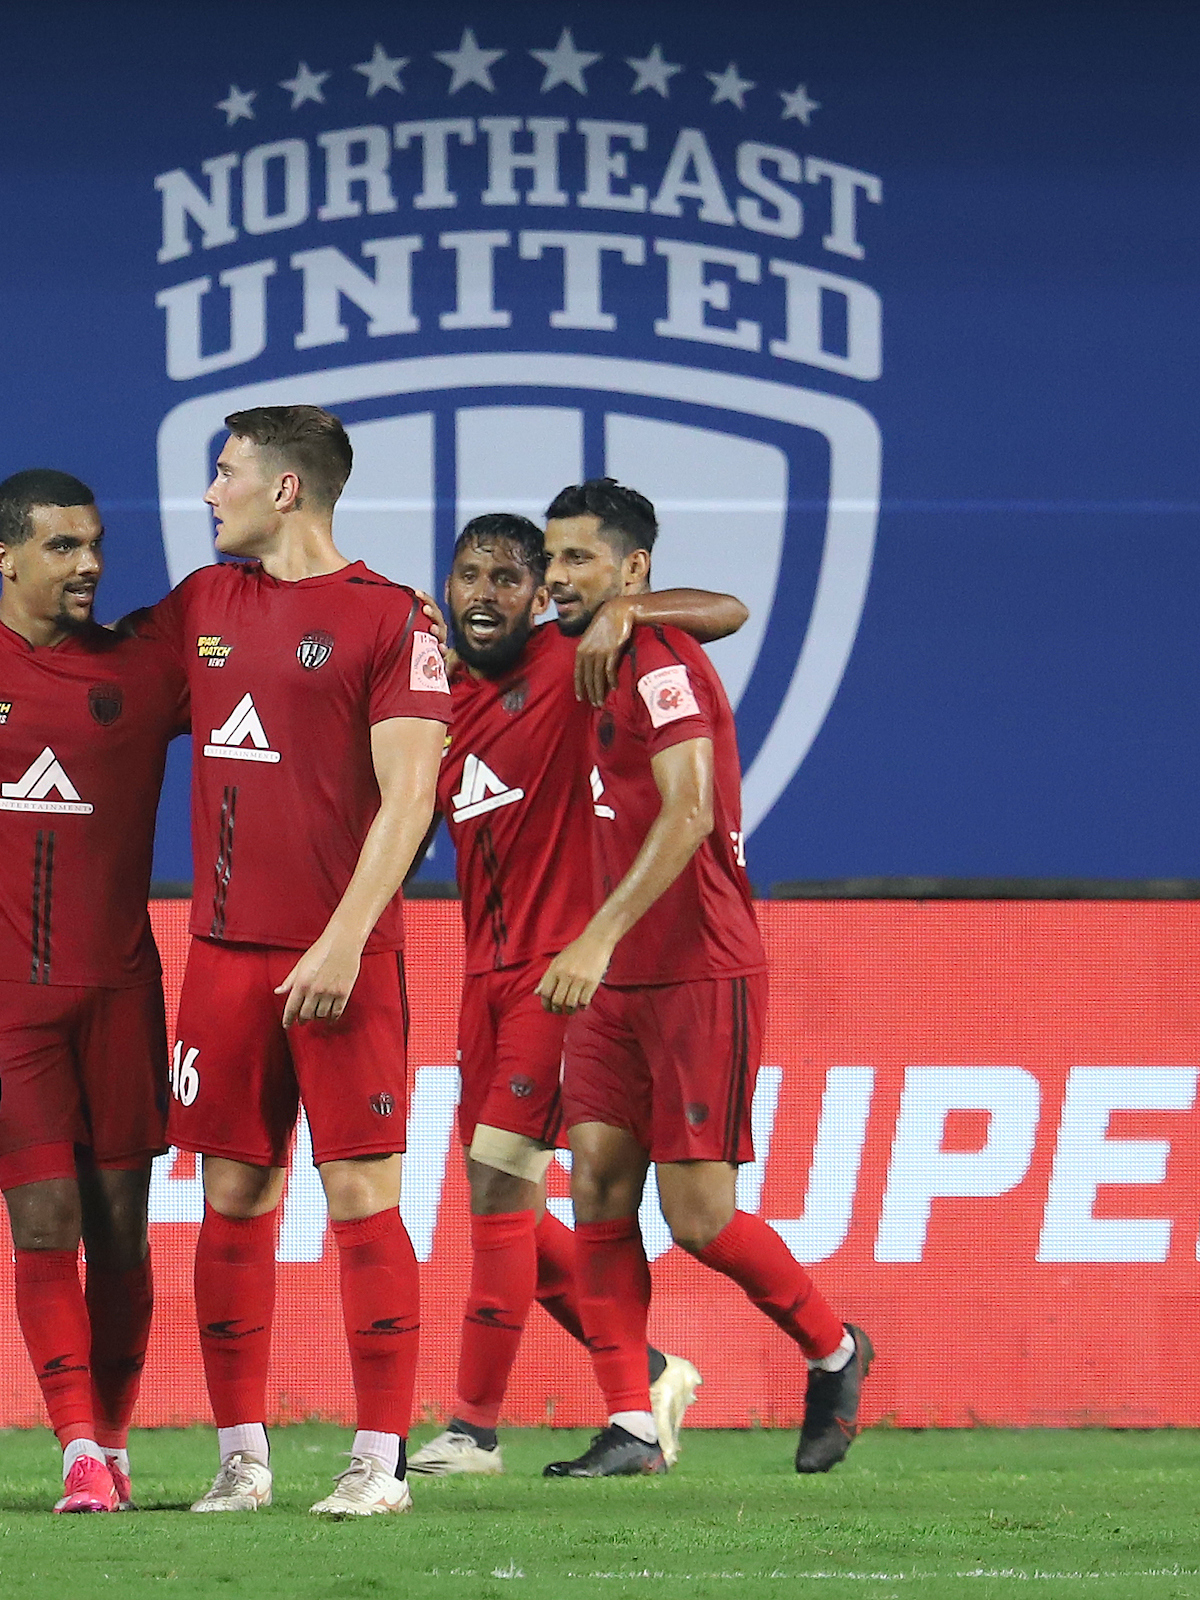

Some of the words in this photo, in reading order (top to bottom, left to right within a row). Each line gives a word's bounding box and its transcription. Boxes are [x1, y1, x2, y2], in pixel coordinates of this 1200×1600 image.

[154, 116, 883, 265] NORTHEAST
[154, 229, 883, 382] UNITED
[198, 646, 231, 657] MATCH
